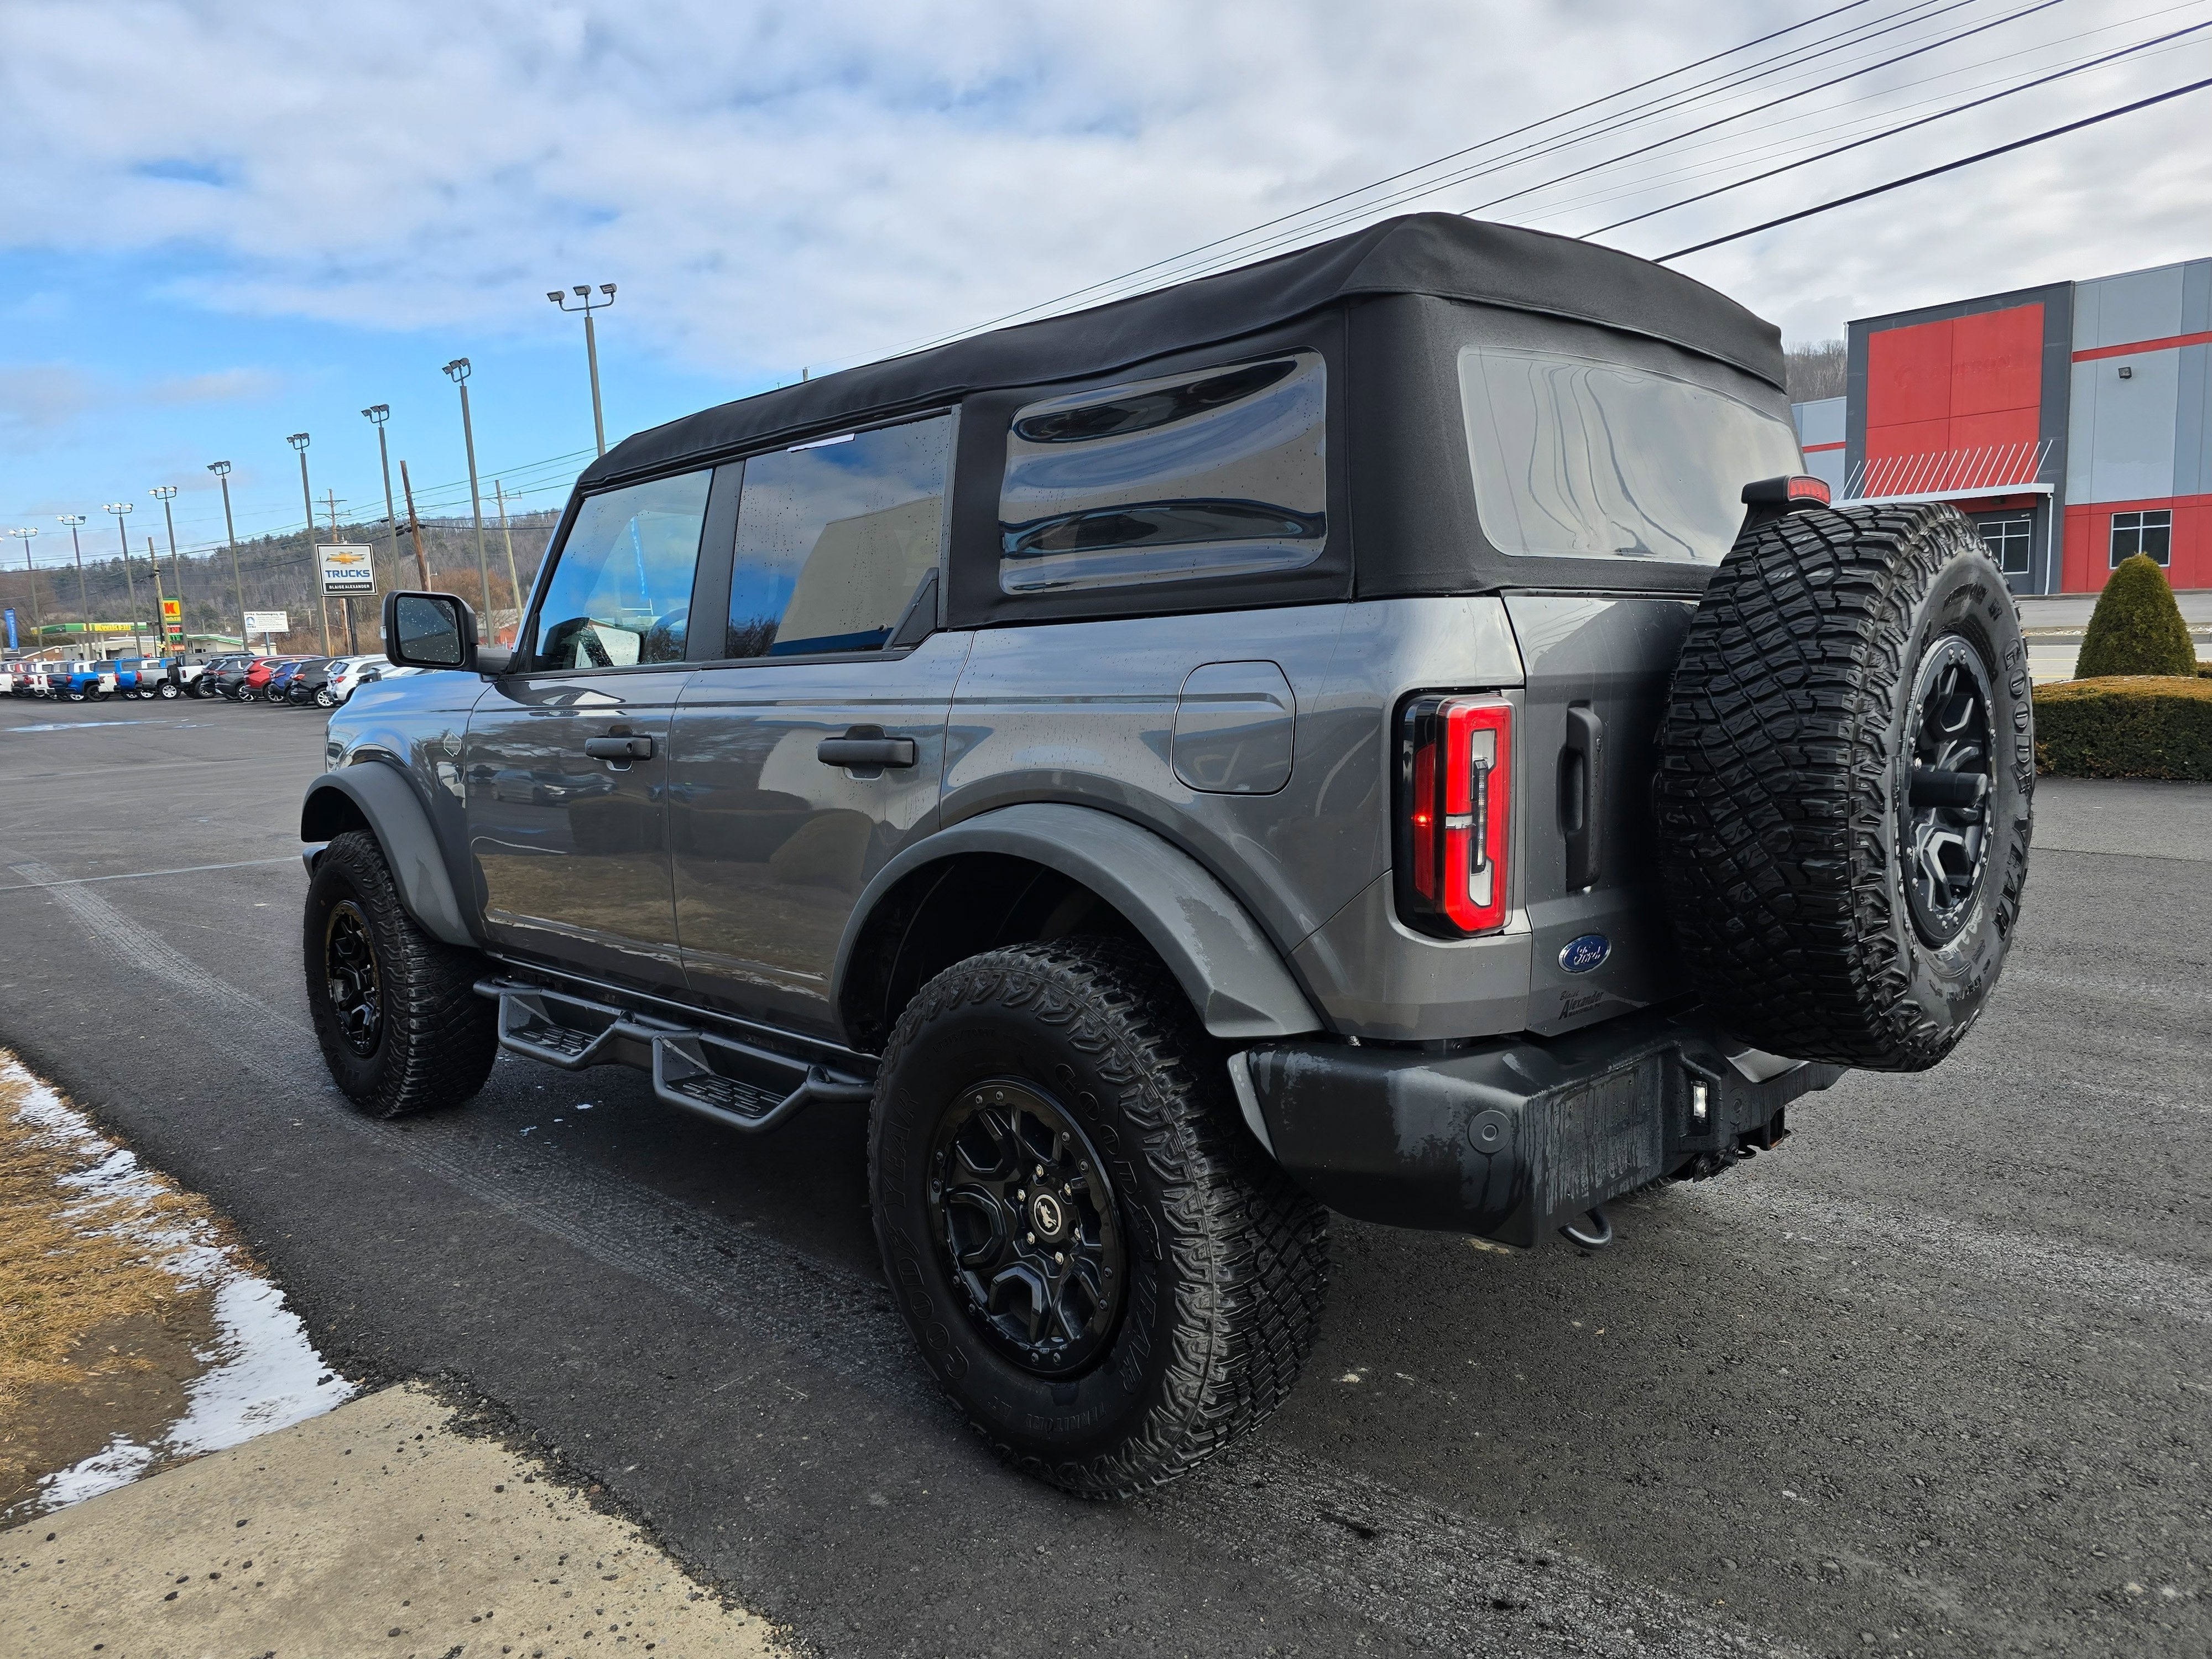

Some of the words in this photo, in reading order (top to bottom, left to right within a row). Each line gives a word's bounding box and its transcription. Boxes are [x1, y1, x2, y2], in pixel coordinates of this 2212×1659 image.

[325, 570, 371, 578] TRUCKS
[164, 603, 177, 614] K
[1573, 945, 1601, 966] Ford
